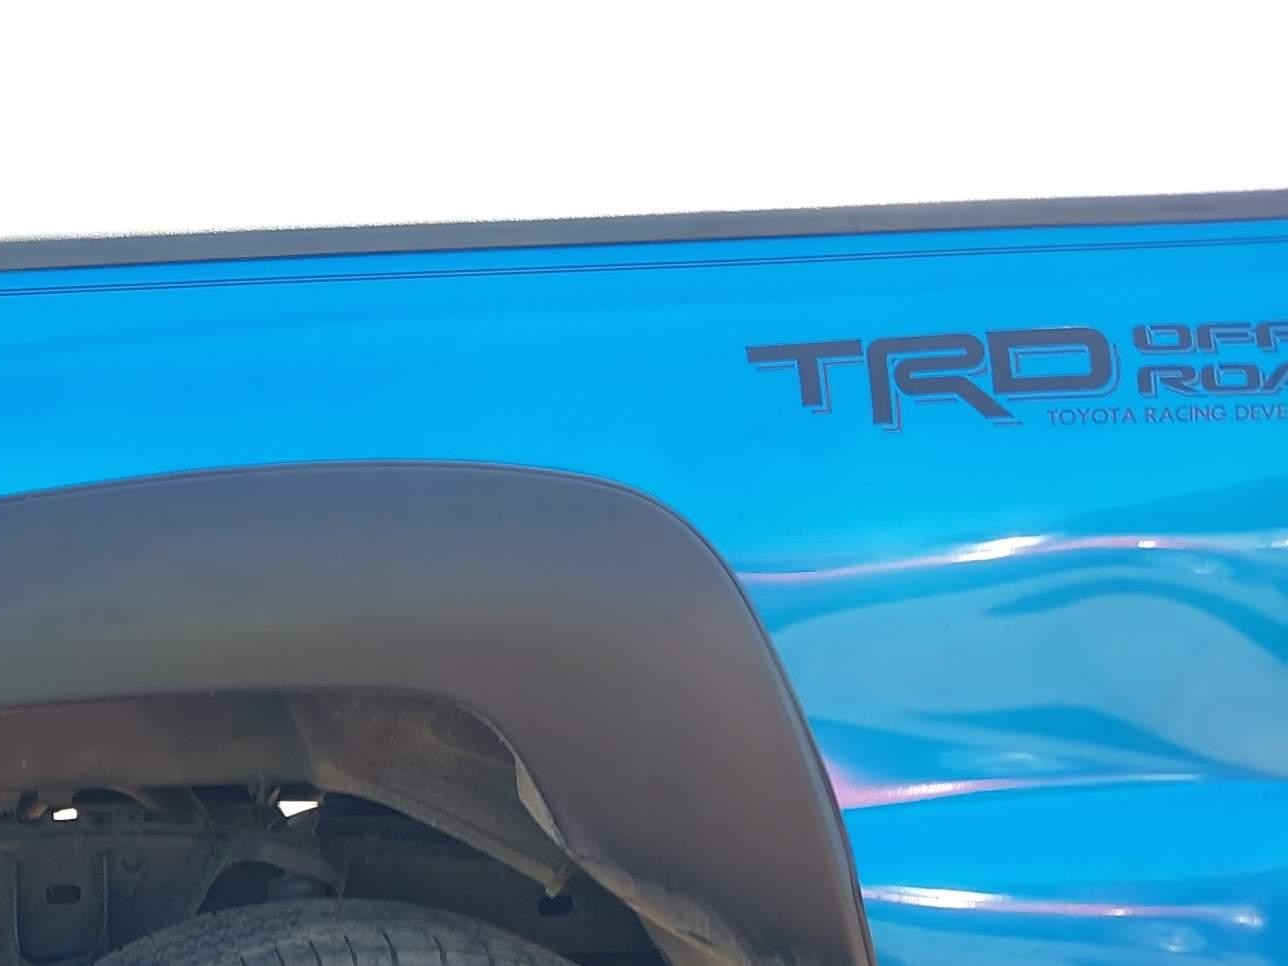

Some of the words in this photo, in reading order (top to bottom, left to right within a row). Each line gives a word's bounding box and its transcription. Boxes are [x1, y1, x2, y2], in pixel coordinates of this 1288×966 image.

[745, 327, 1120, 432] TRD
[1047, 407, 1137, 426] TOYOTA
[1145, 404, 1227, 424] RACING
